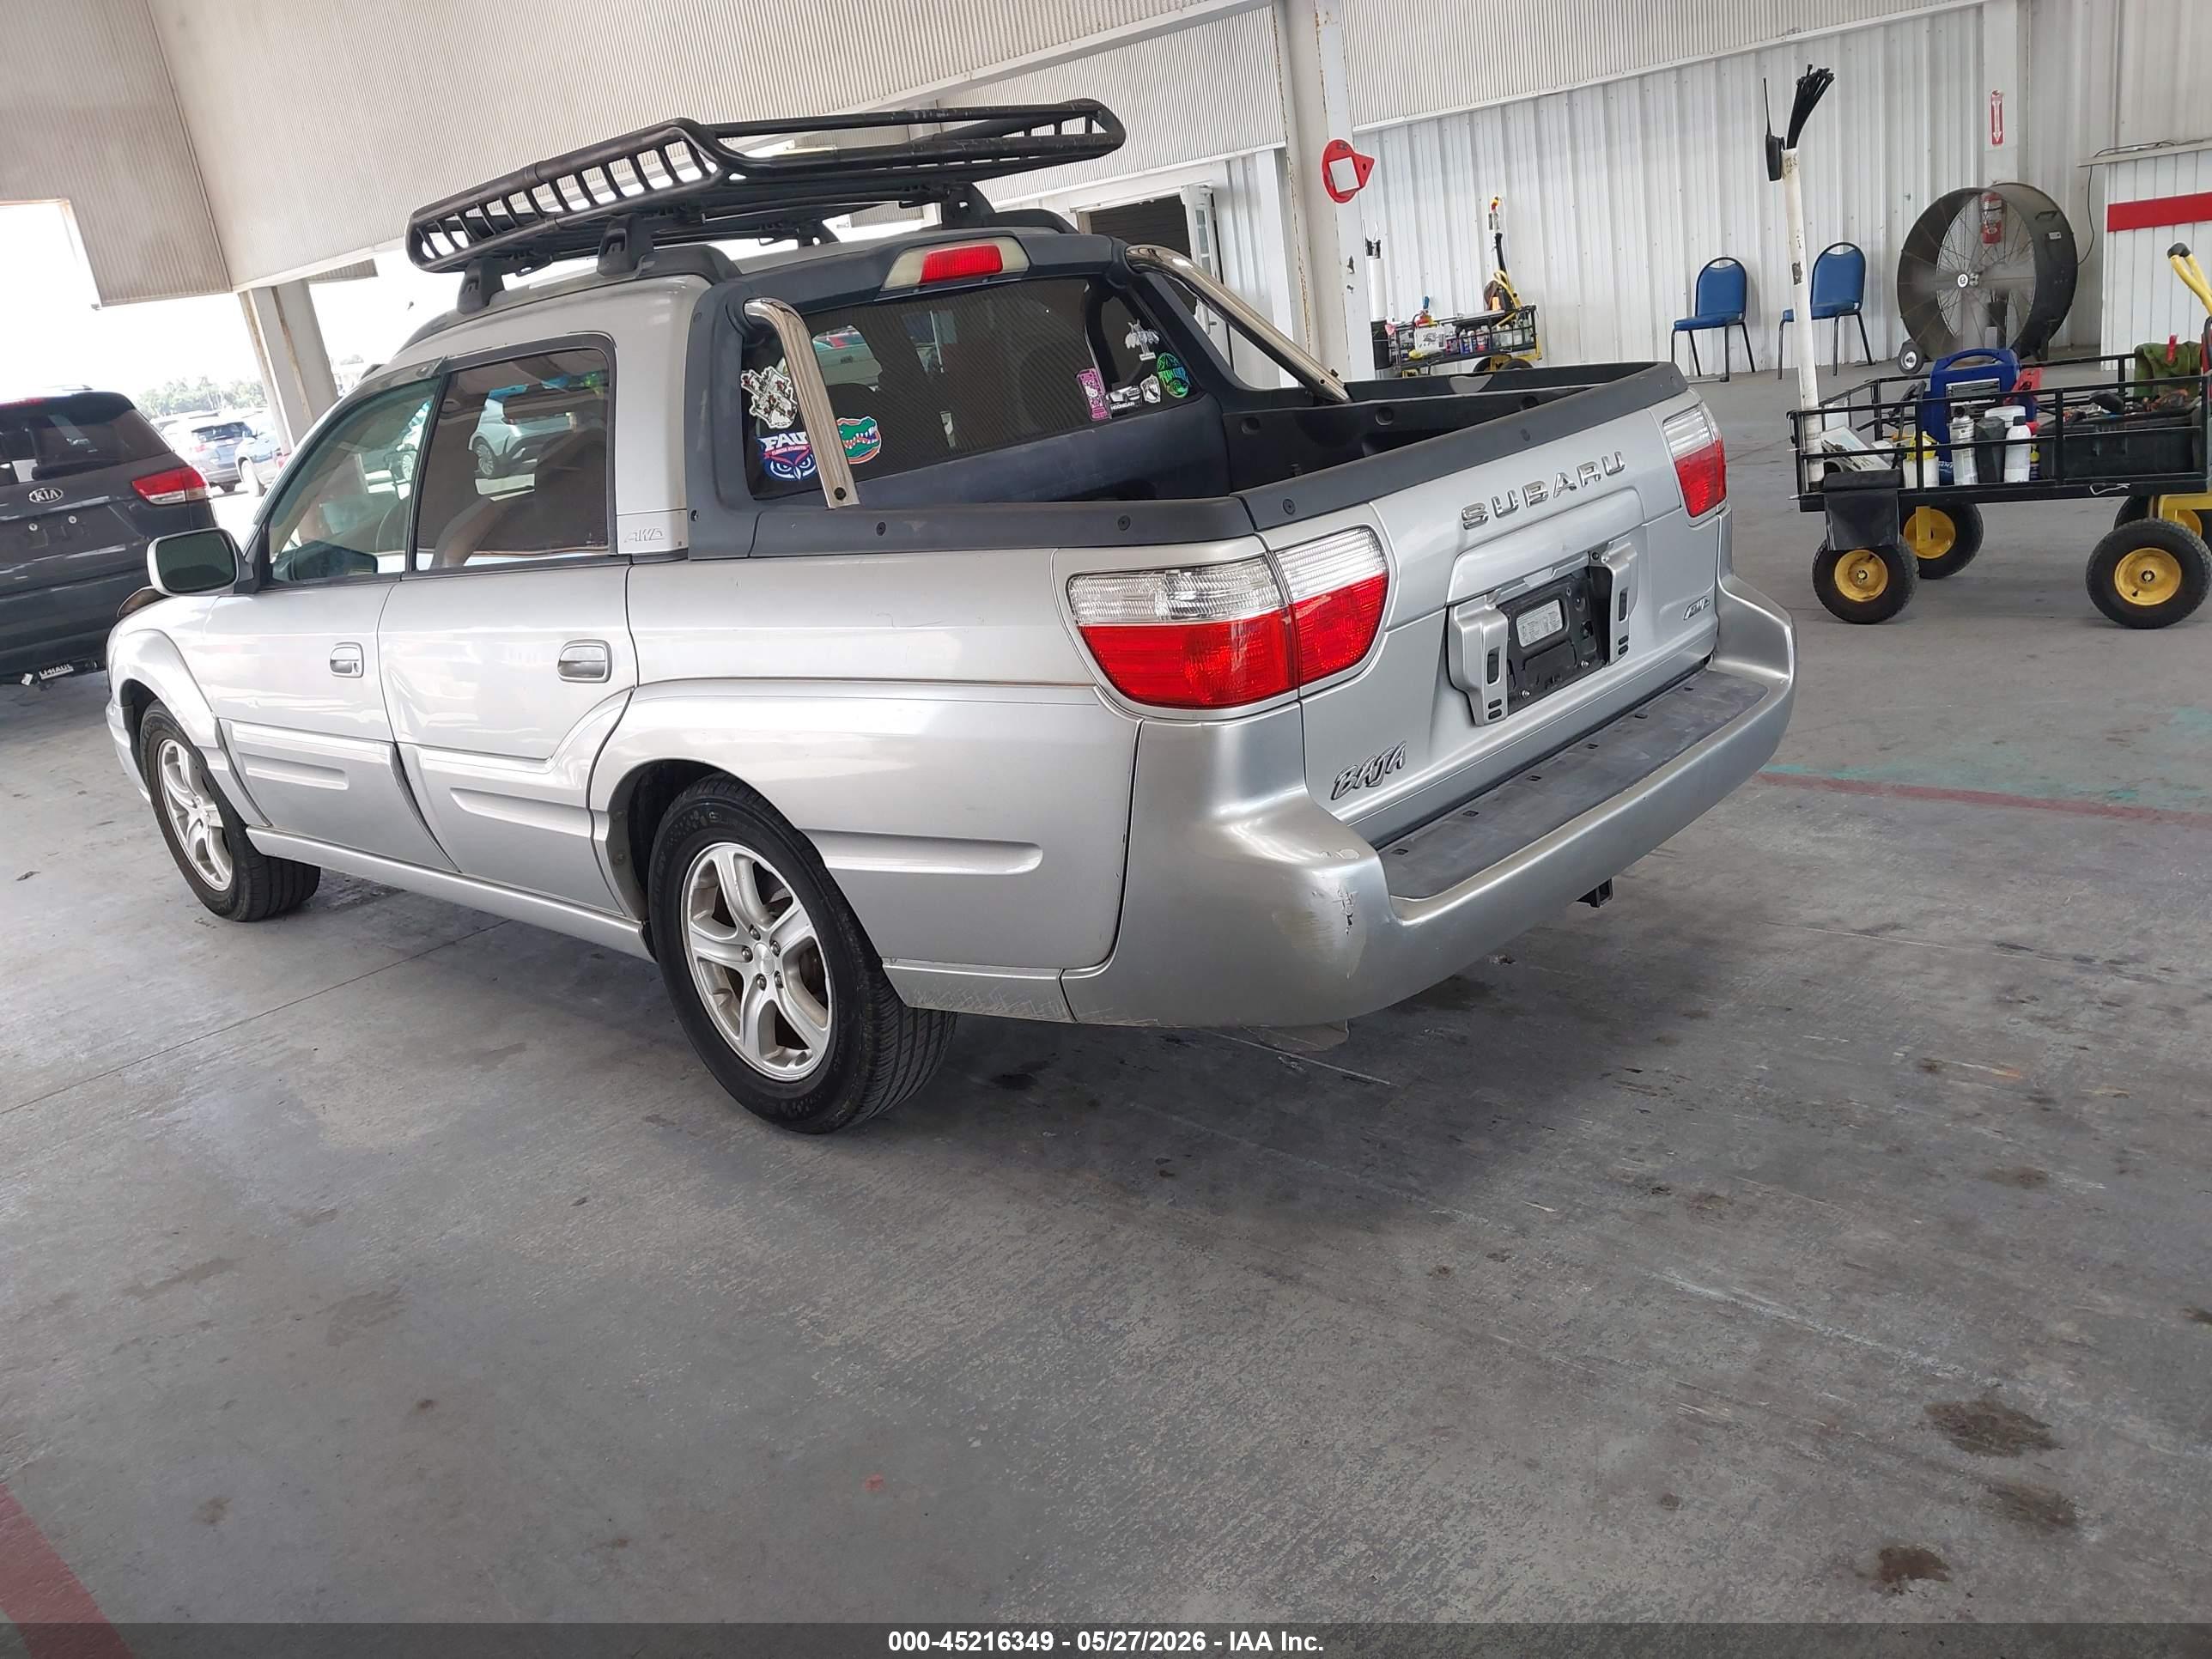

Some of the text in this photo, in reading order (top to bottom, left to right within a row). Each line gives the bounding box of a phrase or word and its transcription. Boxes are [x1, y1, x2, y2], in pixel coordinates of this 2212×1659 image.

[757, 431, 809, 452] FAU
[33, 489, 59, 501] KIA
[1461, 451, 1626, 530] SUBARU
[38, 663, 73, 677] U-HAUL
[1330, 739, 1407, 800] BAJA
